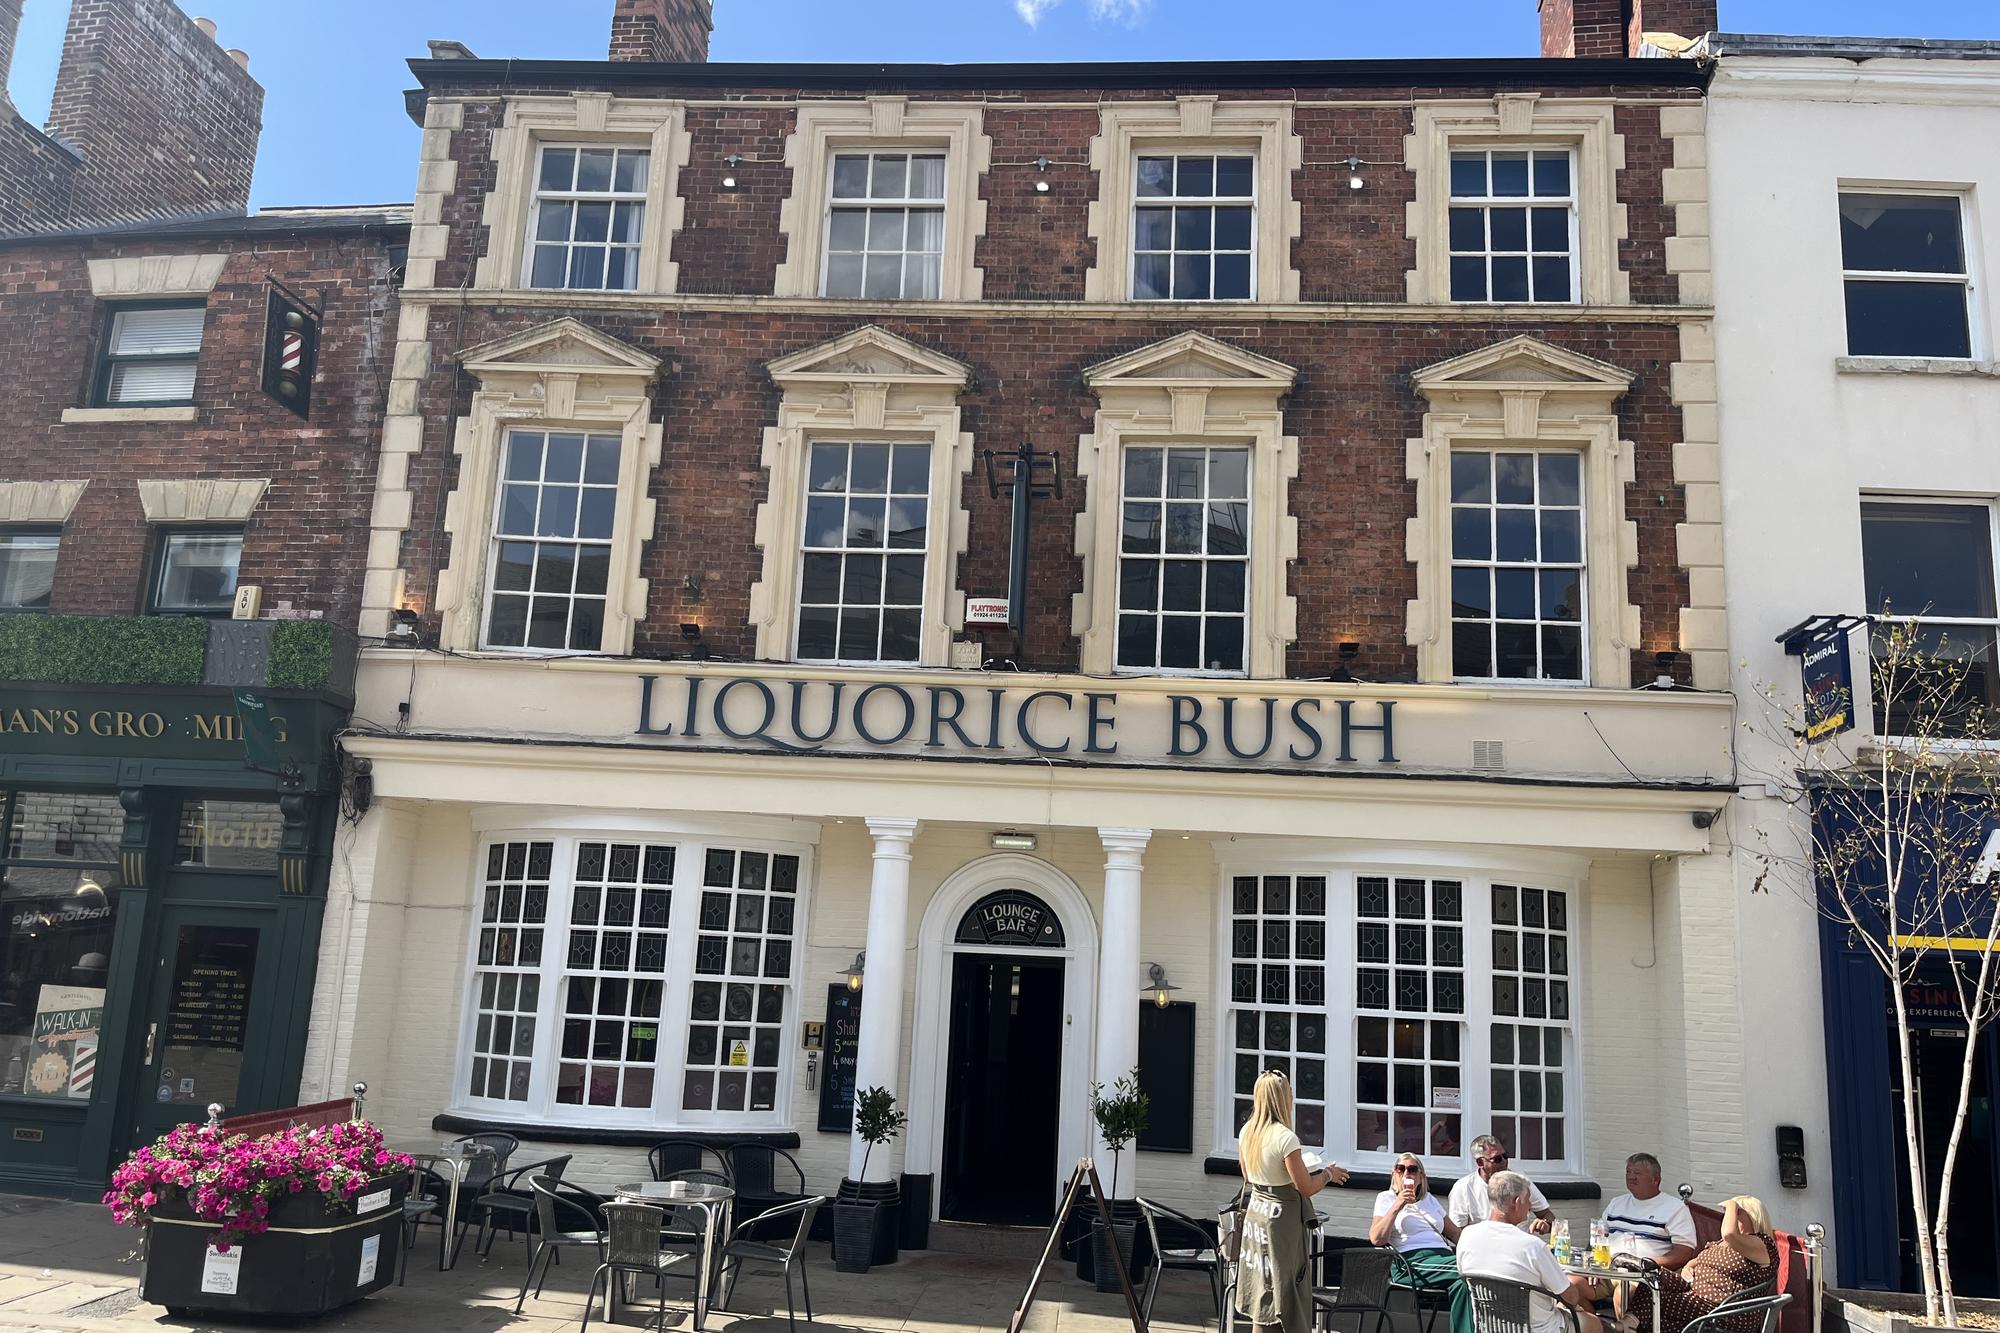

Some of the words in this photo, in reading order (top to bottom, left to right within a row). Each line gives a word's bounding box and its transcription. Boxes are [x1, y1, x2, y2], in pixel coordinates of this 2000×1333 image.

[971, 604, 1008, 613] PLAYTRONIC
[1803, 643, 1838, 669] ADMIRAL
[634, 675, 1118, 753] LIQUORICE
[1166, 695, 1401, 763] BUSH
[983, 904, 1041, 923] LOUNGE
[996, 918, 1026, 932] BAR
[41, 1010, 91, 1031] WALK-IN
[1909, 1008, 1963, 1018] EXPERIENC
